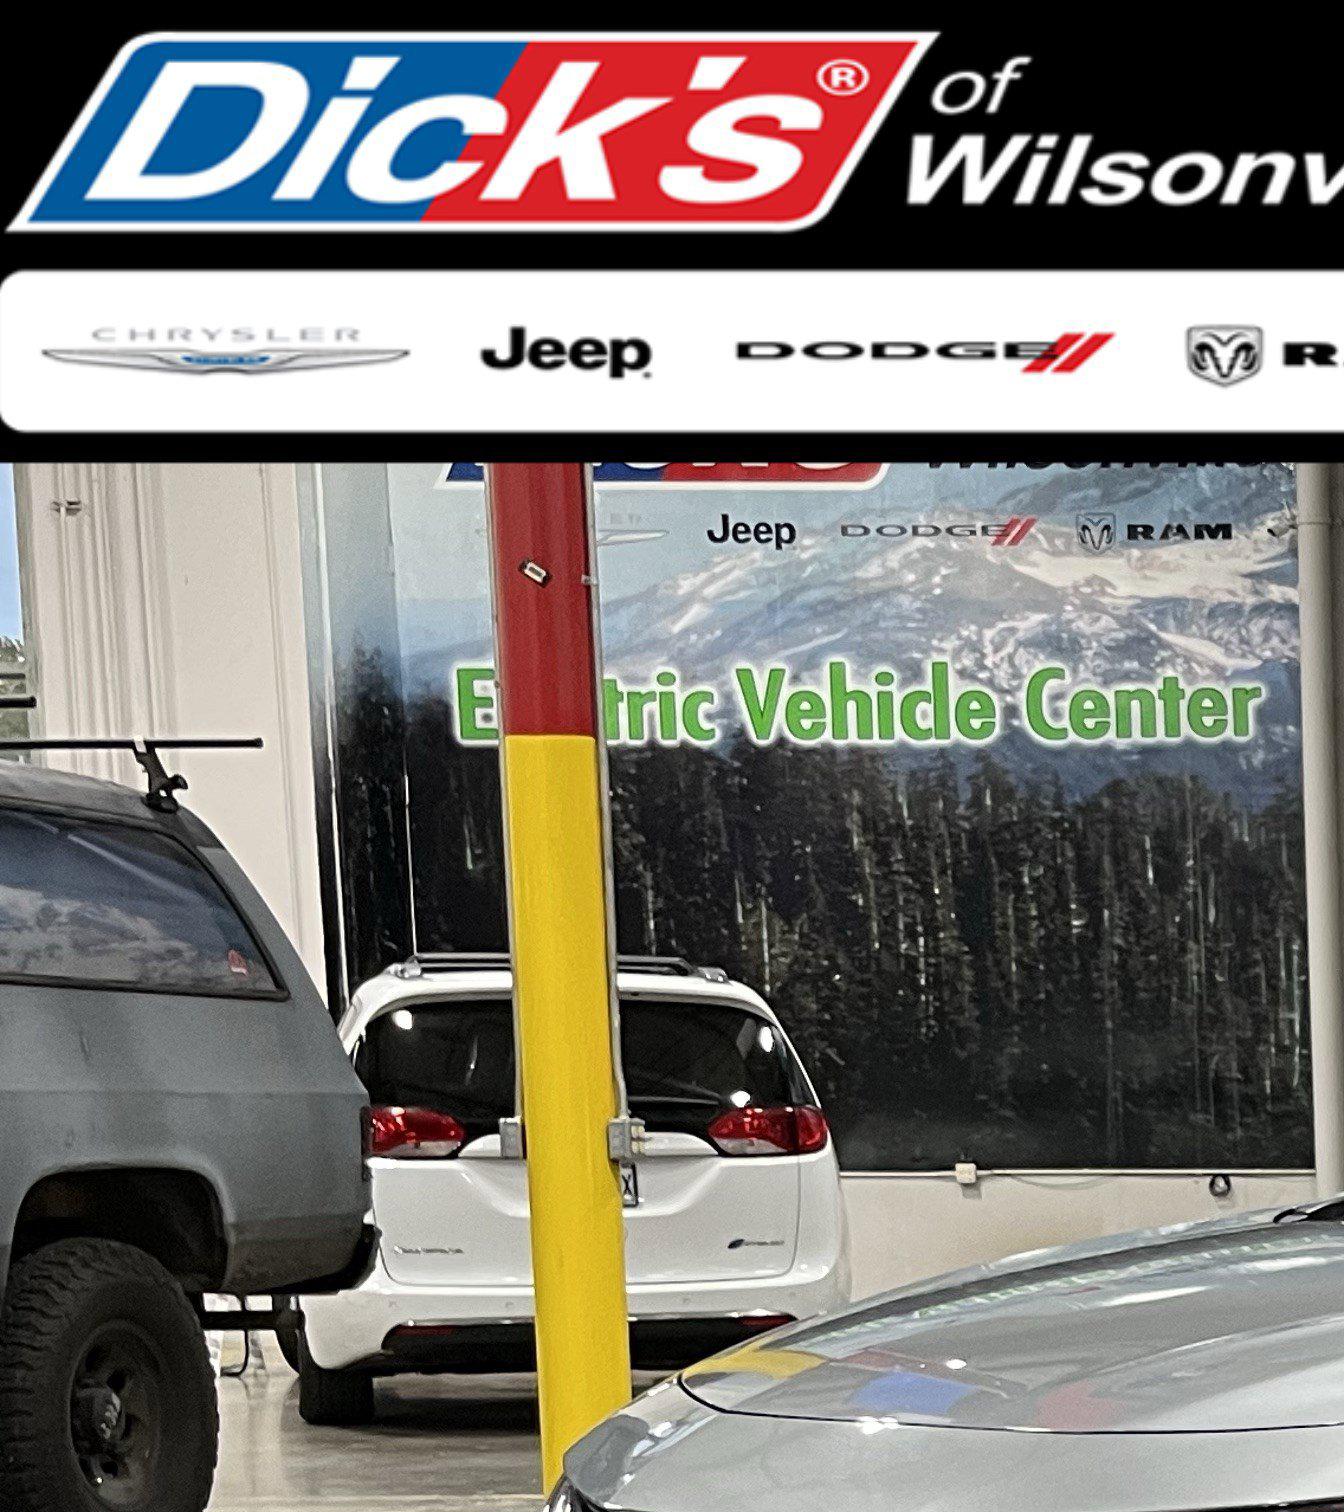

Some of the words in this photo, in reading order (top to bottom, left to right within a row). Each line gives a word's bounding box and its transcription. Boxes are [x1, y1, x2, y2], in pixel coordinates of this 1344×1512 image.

[706, 514, 797, 550] Jeep
[840, 523, 1008, 538] DODGE
[1127, 522, 1234, 541] RAM
[455, 665, 717, 742] Etric
[735, 660, 1000, 742] Vehicle
[1024, 666, 1263, 742] Center
